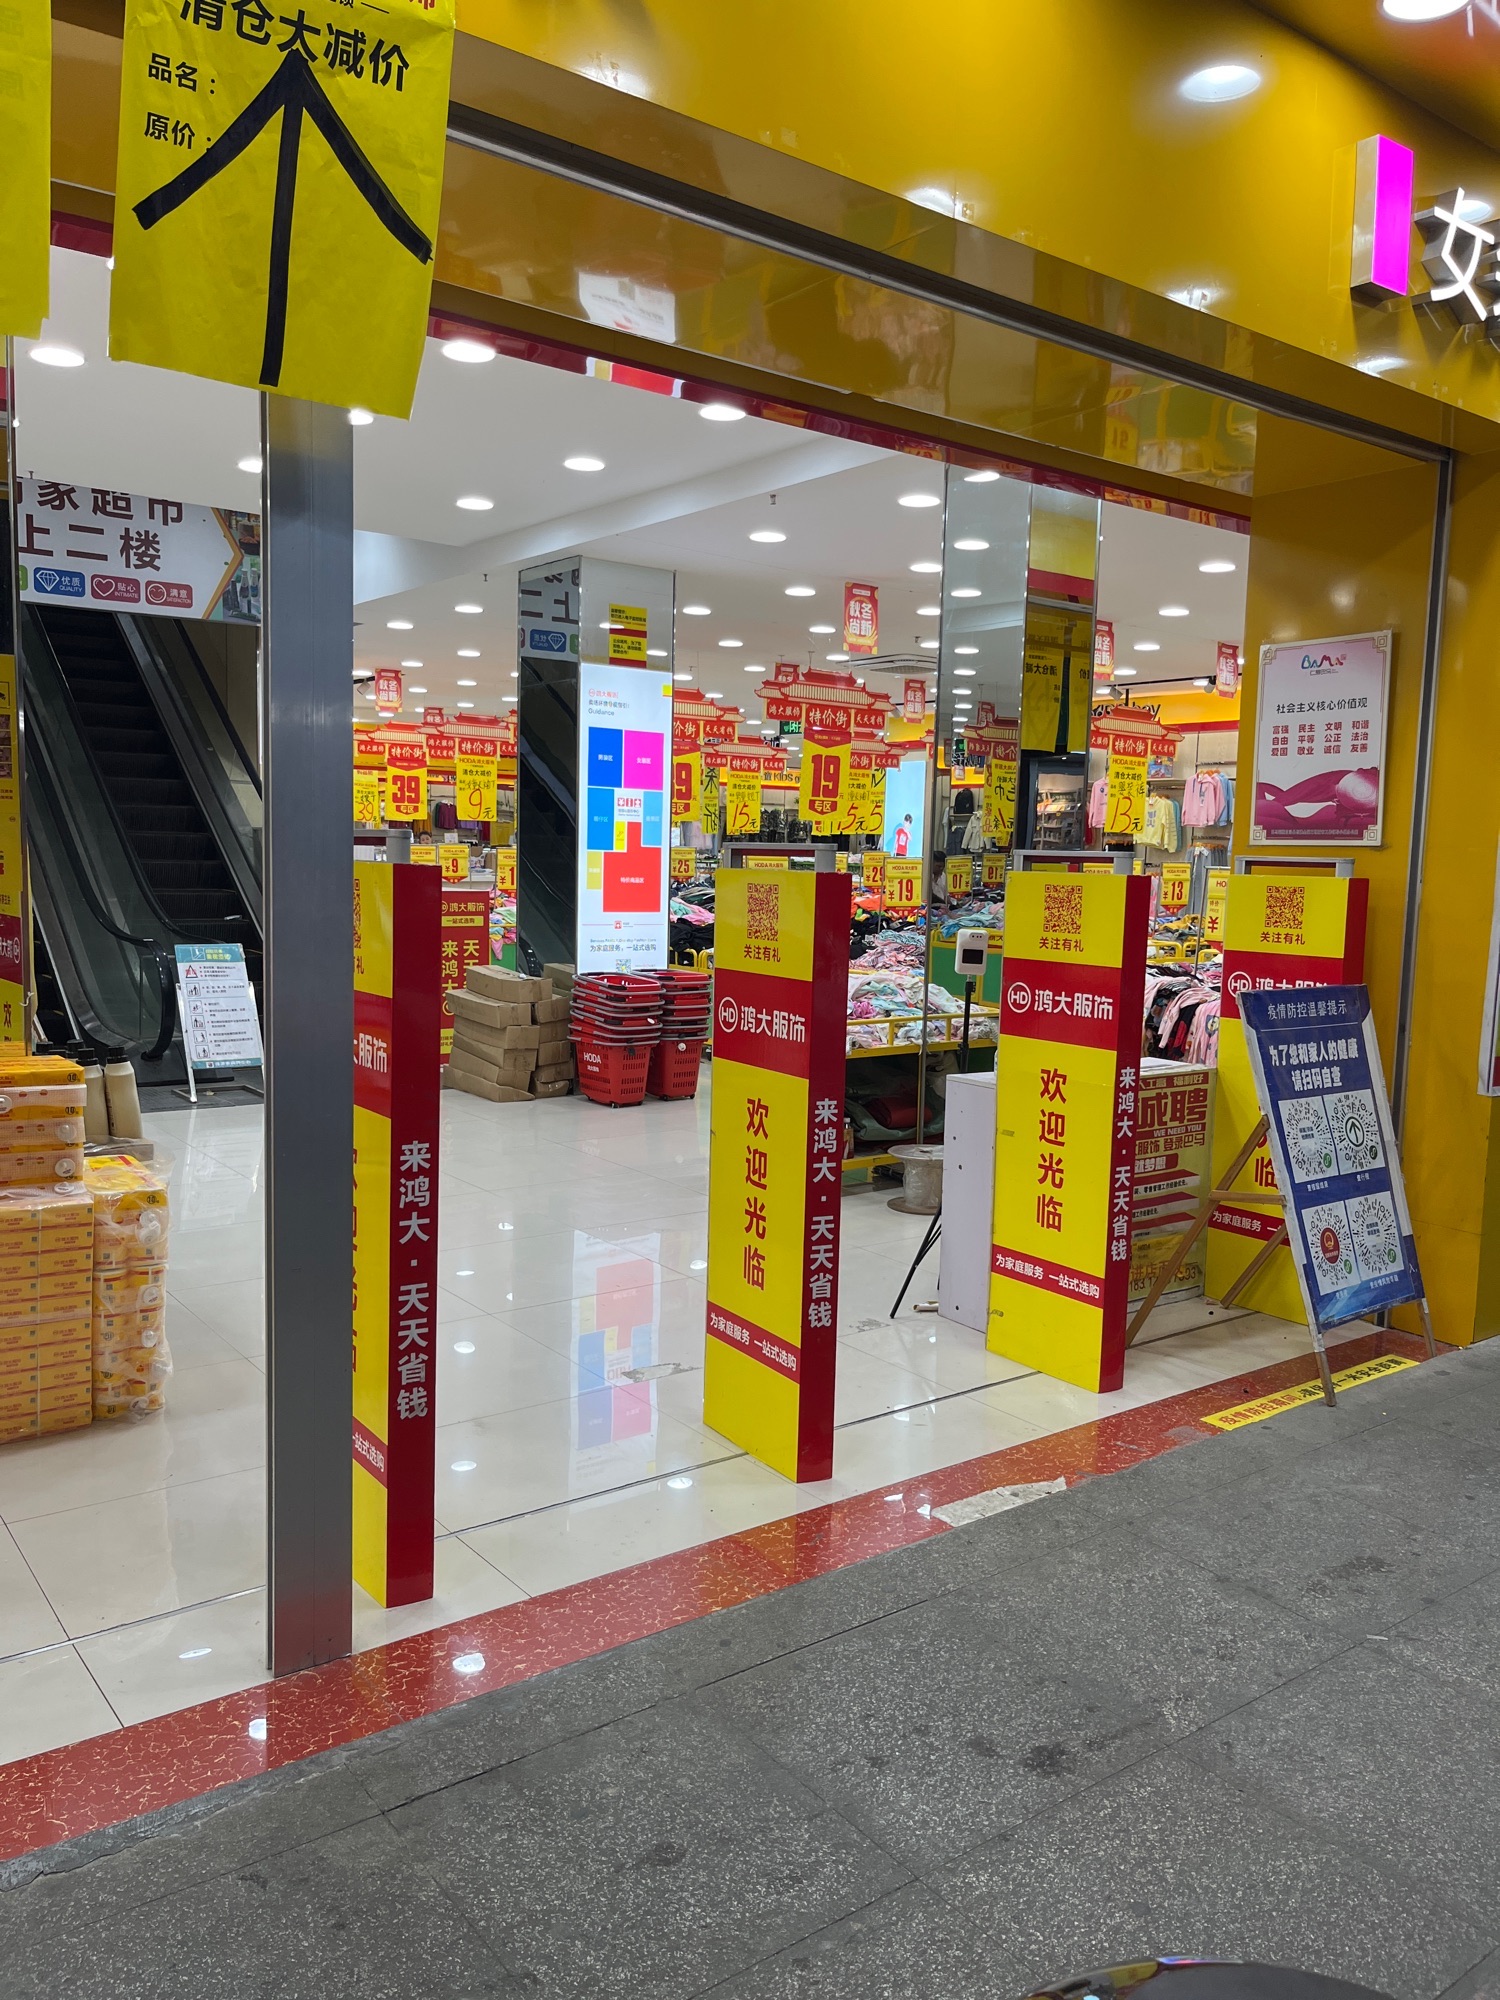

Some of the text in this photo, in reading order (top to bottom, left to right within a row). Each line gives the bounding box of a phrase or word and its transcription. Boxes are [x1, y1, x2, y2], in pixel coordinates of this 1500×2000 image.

[180, 0, 409, 92] 清仓大减价
[18, 514, 161, 572] 上二楼
[59, 584, 83, 593] QUALITY
[61, 575, 81, 587] 优质
[117, 582, 136, 593] 贴心
[114, 591, 139, 599] INTIMATE
[849, 600, 872, 619] 秋冬
[849, 618, 872, 637] 尚新
[379, 679, 398, 691] 秋冬
[907, 690, 922, 701] 秋冬
[769, 704, 800, 717] 鸿大服饰
[1276, 697, 1368, 714] 社会主义核心价值观
[809, 708, 847, 728] 特价街
[856, 710, 884, 726] 天天省钱
[705, 725, 733, 736] 天天省钱
[1272, 720, 1370, 735] 富强 民主 文明 和谐
[1272, 731, 1369, 746] 自由 平等 公正 法治
[390, 745, 423, 759] 特价街
[460, 741, 495, 755] 特价街
[1115, 738, 1145, 755] 特价街
[1271, 743, 1368, 757] 爱国 敬业 诚信 友善
[459, 757, 476, 765] HODA
[732, 758, 759, 771] 特价街
[1112, 757, 1128, 766] HODA
[463, 768, 493, 777] 清仓大减价
[773, 773, 793, 782] KIDS
[811, 753, 841, 799] 19
[1114, 771, 1142, 781] 清仓大减价
[673, 762, 692, 801] 9
[849, 782, 867, 790] 大减价
[392, 775, 421, 804] 39
[400, 805, 415, 814] 专区
[468, 788, 495, 820] 9 元
[814, 801, 832, 812] 专区
[732, 802, 750, 829] 15
[856, 816, 868, 831] 元
[1131, 818, 1143, 832] 元
[449, 902, 485, 912] 鸿大服饰
[446, 917, 475, 925] 一站式选购
[1038, 936, 1084, 953] 关注有礼
[1260, 931, 1306, 945] 关注有礼
[744, 944, 781, 963] 关注有礼
[1034, 988, 1113, 1021] 鸿大服饰
[1268, 1000, 1348, 1020] 疫情防控温馨提示
[741, 1009, 806, 1042] 鸿大服饰
[583, 1052, 602, 1064] HODA
[1269, 1038, 1359, 1067] 为了您和家人的健康
[1173, 1074, 1204, 1086] 福利好
[1291, 1066, 1343, 1092] 请扫码自查
[1167, 1127, 1185, 1135] NEED
[1187, 1124, 1202, 1132] YOU
[1036, 1067, 1067, 1232] 欢迎光临
[1135, 1133, 1205, 1157] 服饰 登录巴马
[743, 1098, 769, 1292] 欢迎光临
[1212, 1210, 1262, 1232] 为家庭服务
[995, 1253, 1100, 1299] 为家庭服务 一站式选购
[710, 1312, 797, 1373] 为家庭服务 一站式选购
[1219, 1394, 1300, 1426] 疫情防控期间
[352, 1432, 384, 1472] 站式选购
